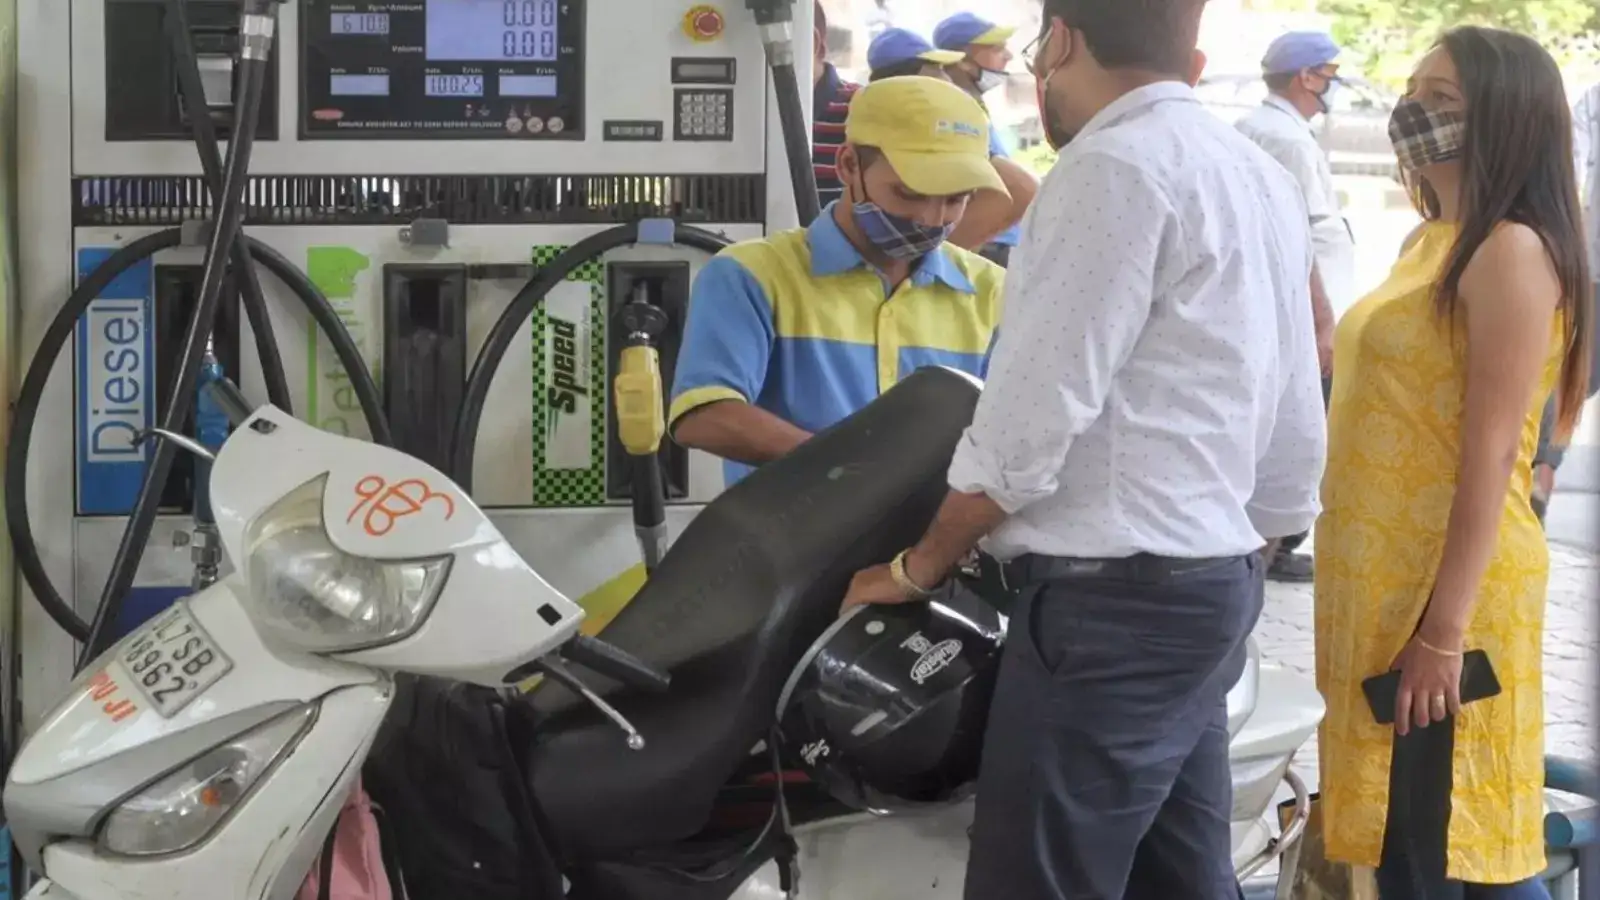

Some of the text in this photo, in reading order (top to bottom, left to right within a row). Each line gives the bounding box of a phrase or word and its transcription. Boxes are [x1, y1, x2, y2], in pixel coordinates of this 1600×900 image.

[503, 31, 554, 57] 0.00
[91, 305, 140, 455] Diesel
[548, 315, 588, 415] Speed
